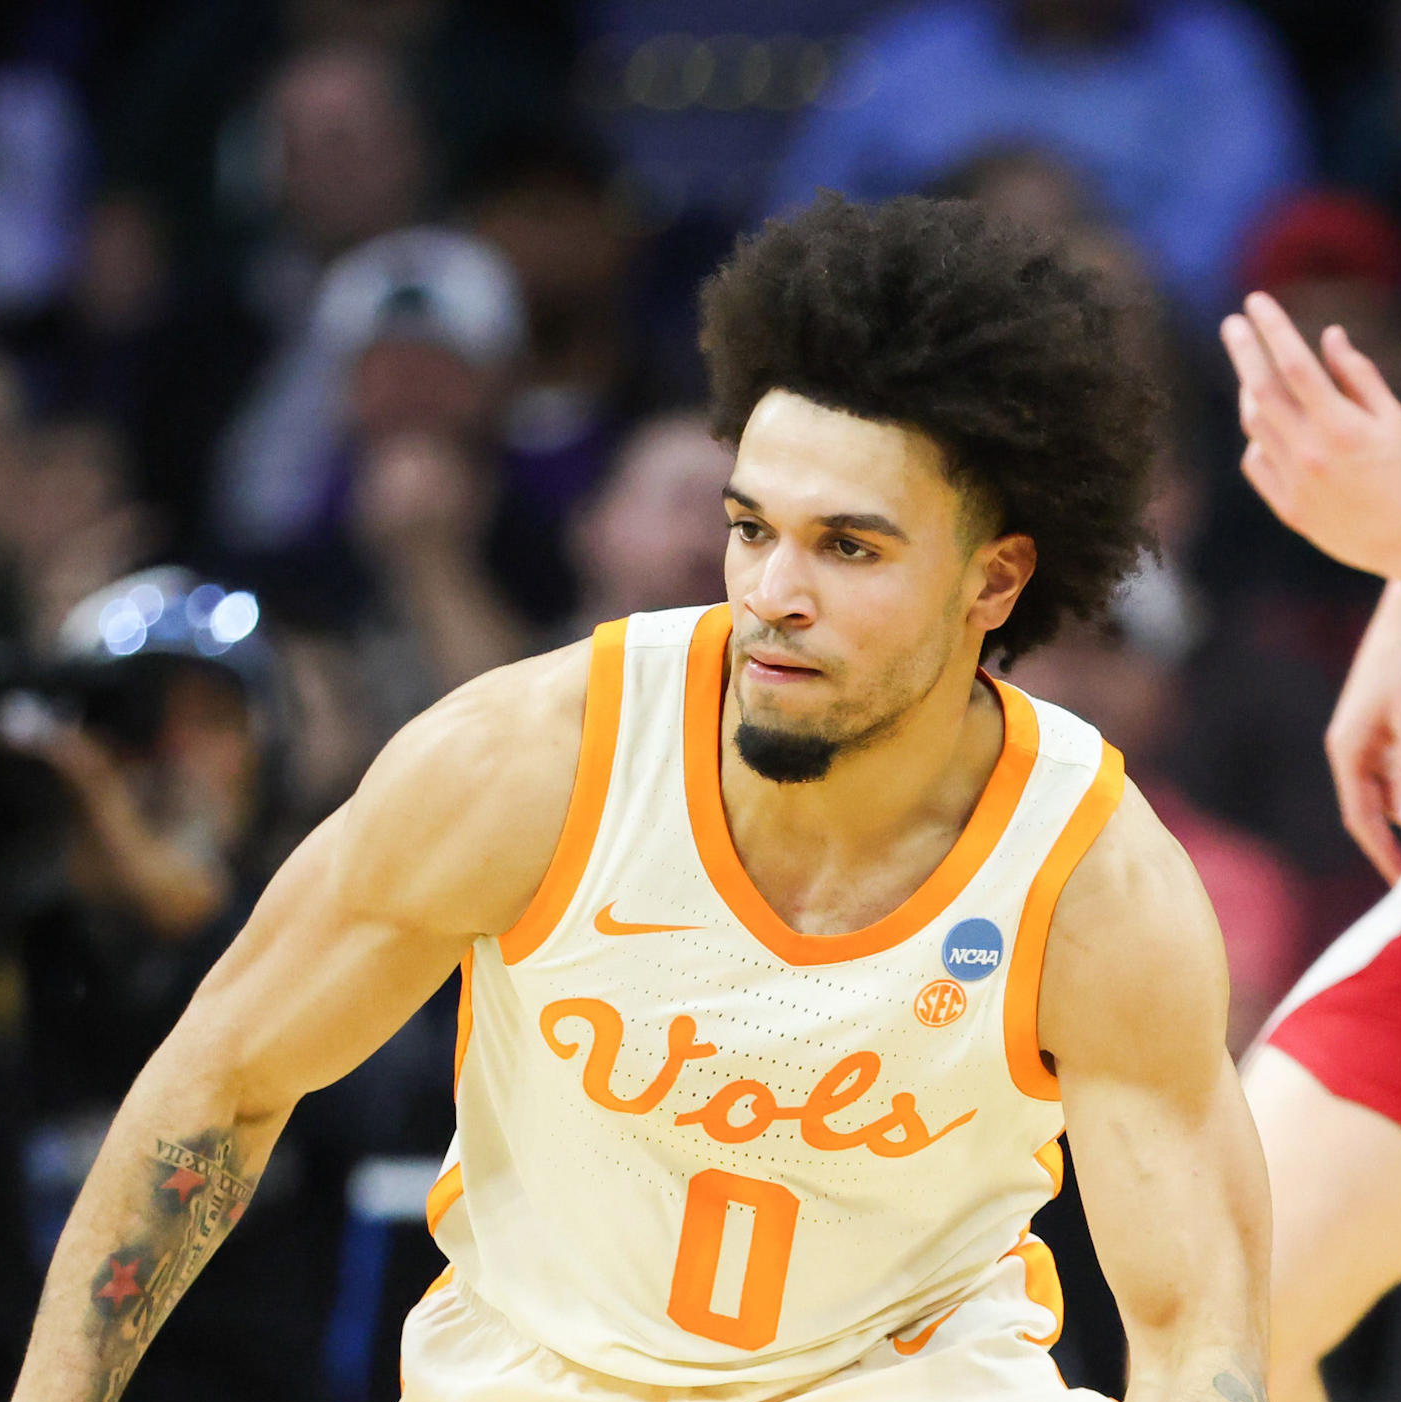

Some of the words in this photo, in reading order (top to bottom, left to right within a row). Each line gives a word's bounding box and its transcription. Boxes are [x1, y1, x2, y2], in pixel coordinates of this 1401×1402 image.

[918, 983, 962, 1024] SEC
[949, 947, 999, 967] NCAA
[539, 997, 979, 1158] Vols
[666, 1168, 800, 1351] 0
